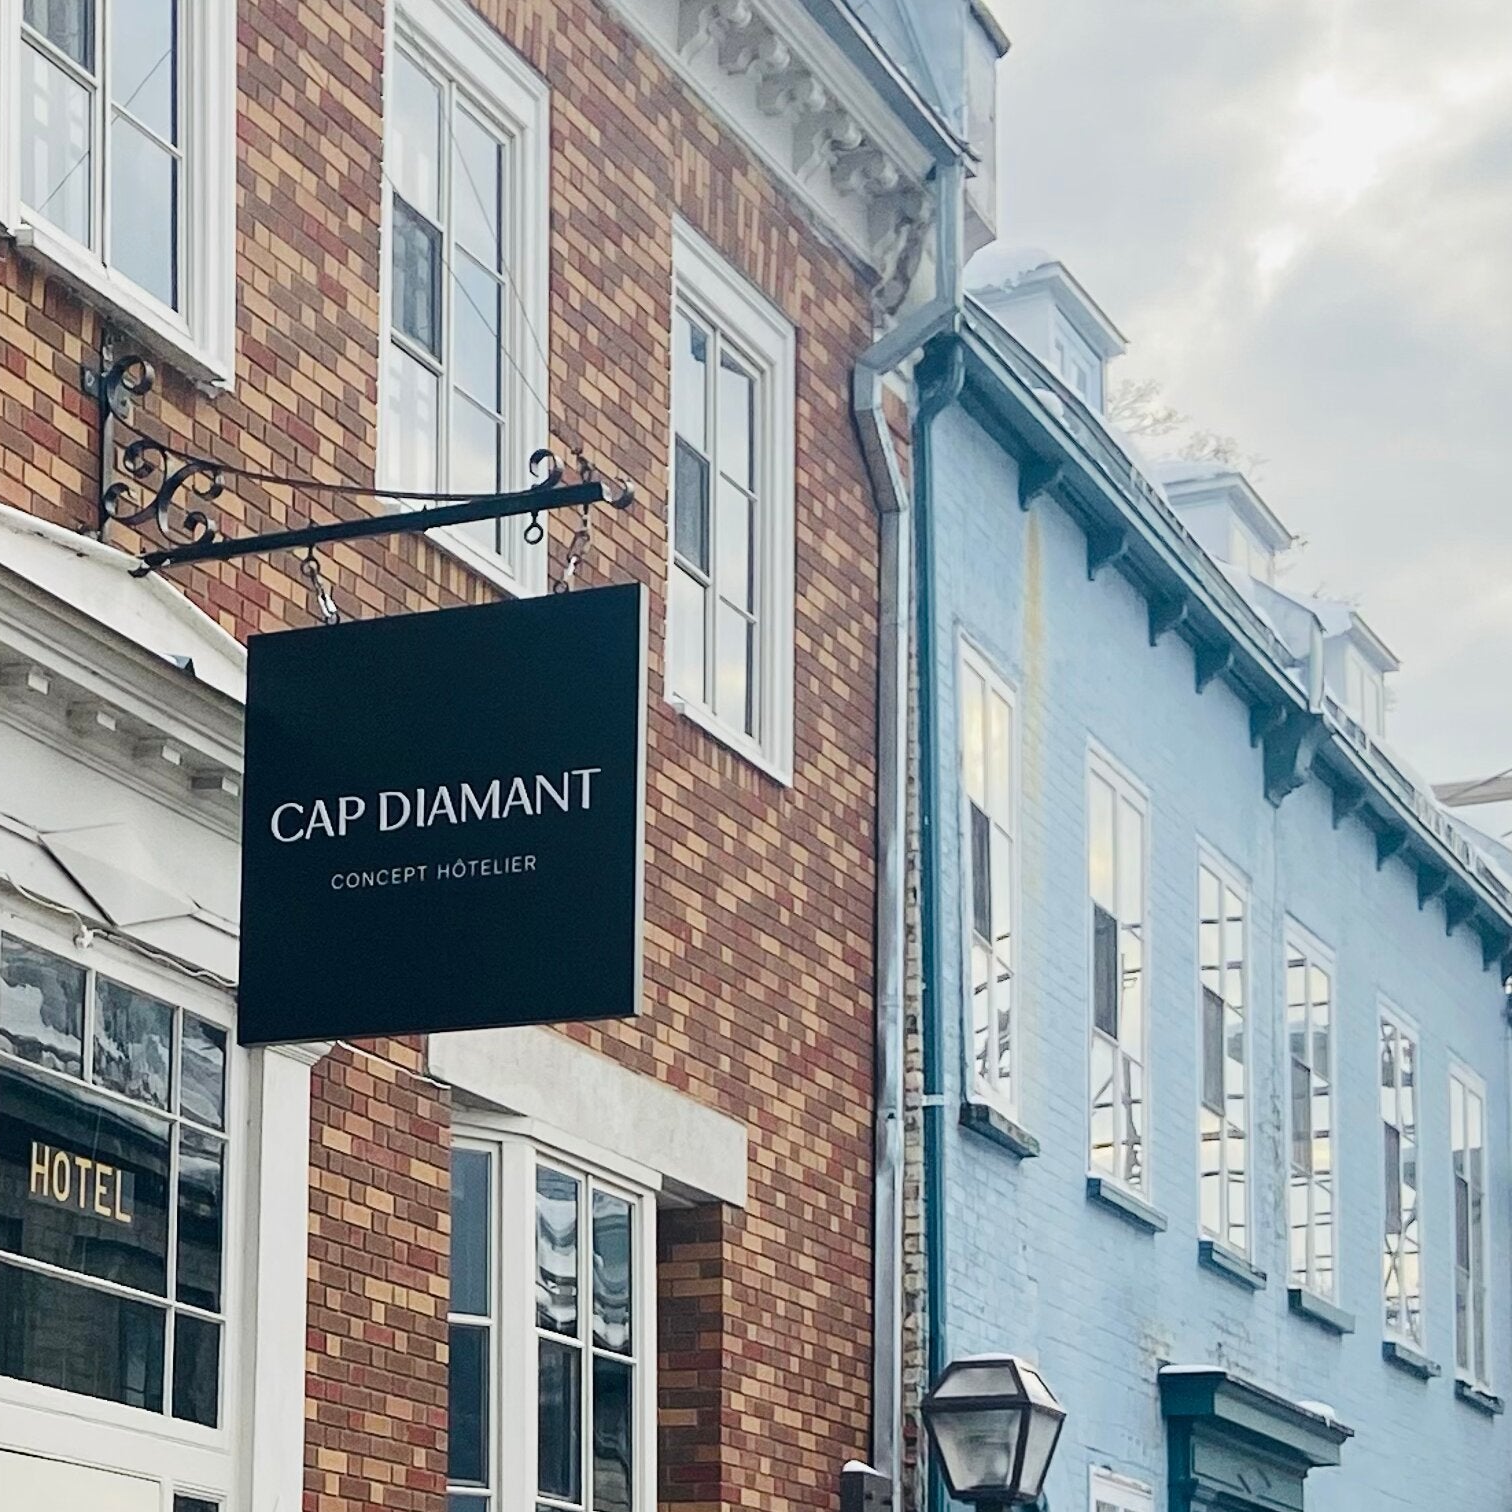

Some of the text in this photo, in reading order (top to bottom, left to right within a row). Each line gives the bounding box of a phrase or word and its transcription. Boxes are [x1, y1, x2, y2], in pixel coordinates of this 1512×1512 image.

[271, 768, 602, 842] CAP DIAMANT
[331, 855, 537, 890] CONCEPT HÔTELIER
[30, 1141, 131, 1223] HOTEL
